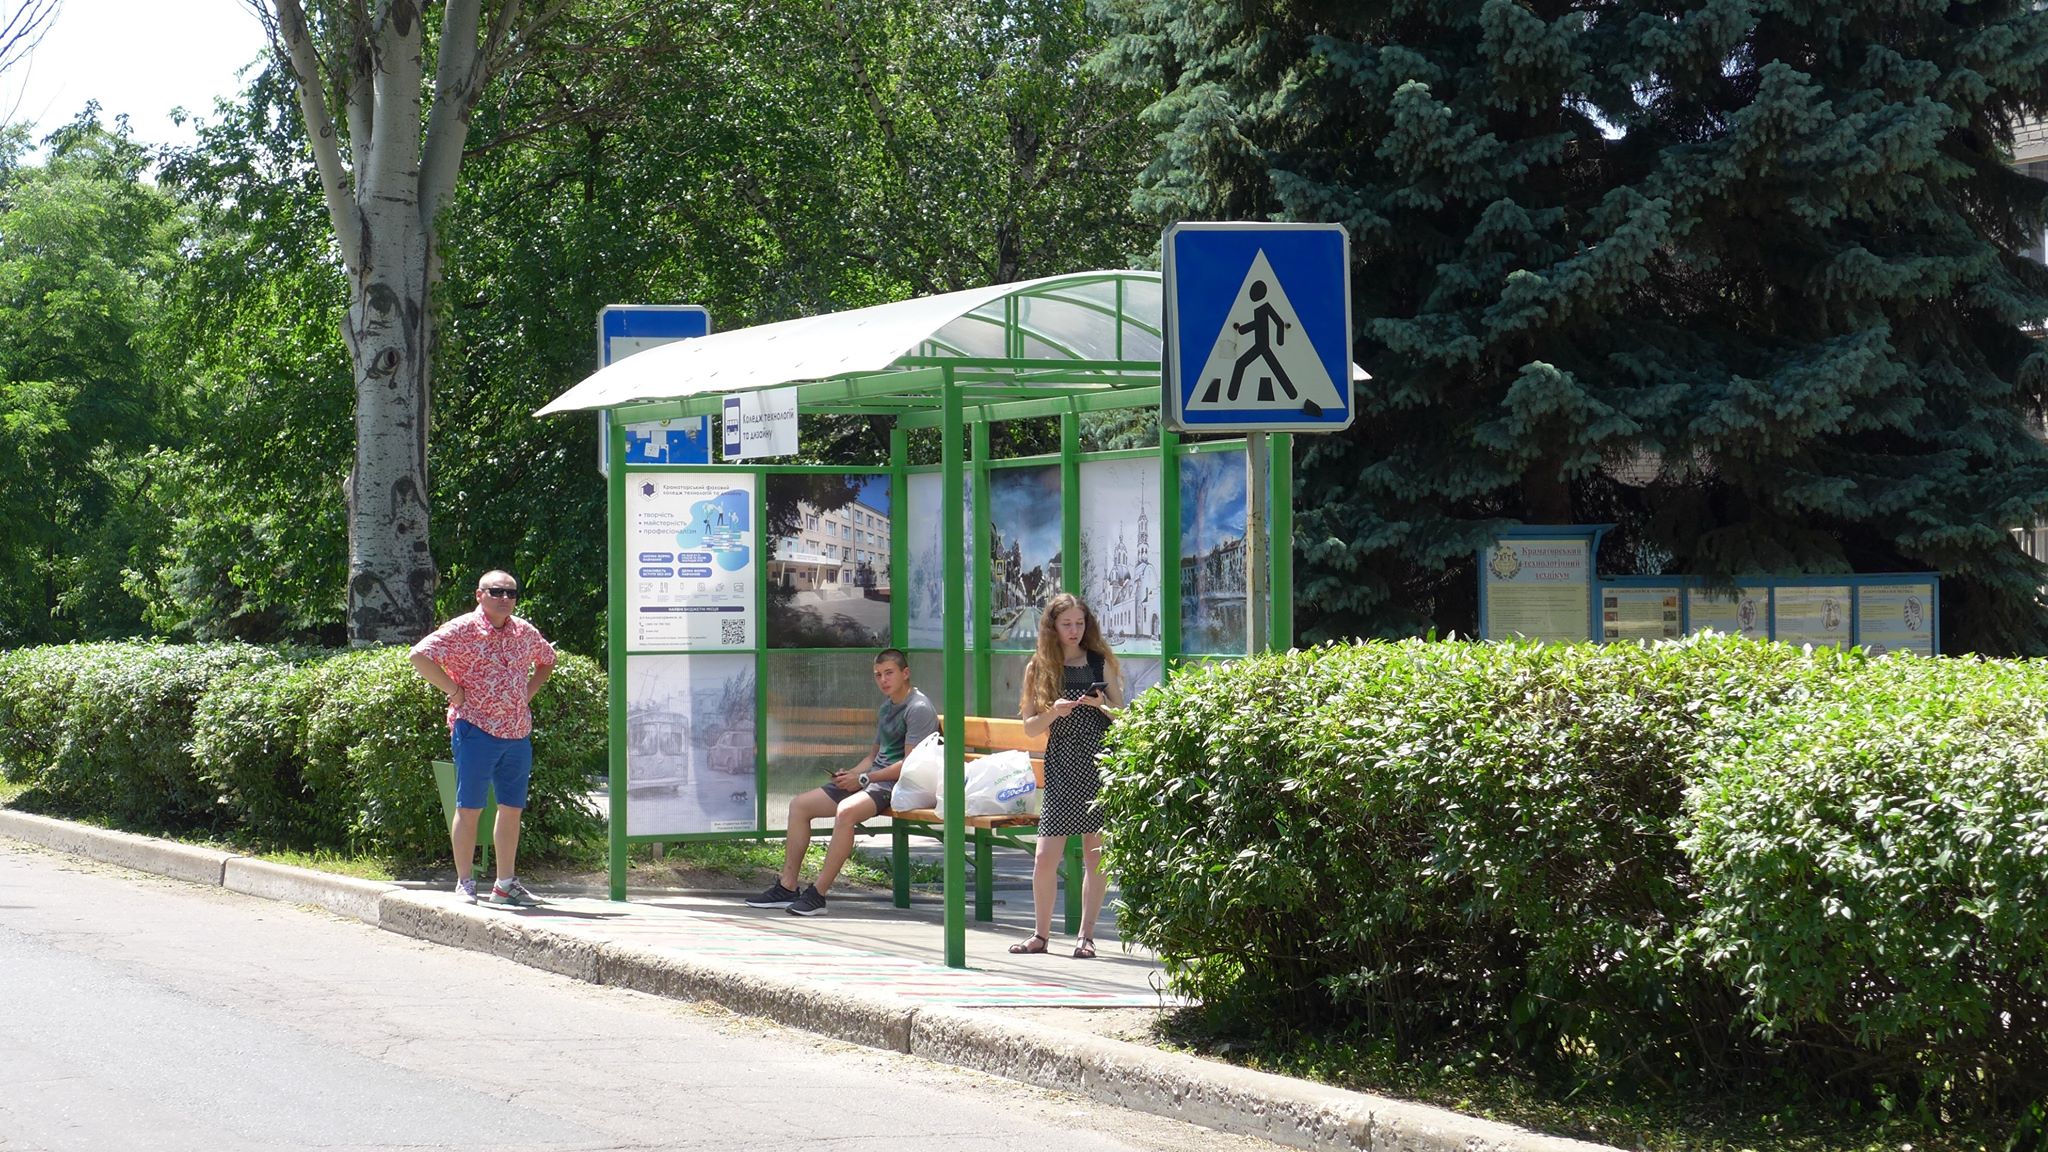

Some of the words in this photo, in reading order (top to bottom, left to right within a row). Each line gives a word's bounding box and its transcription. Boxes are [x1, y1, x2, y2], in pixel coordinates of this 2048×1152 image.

[743, 413, 763, 424] Коледж
[764, 408, 794, 422] технологій
[750, 427, 772, 440] дизайну
[1521, 546, 1582, 557] Краматорський
